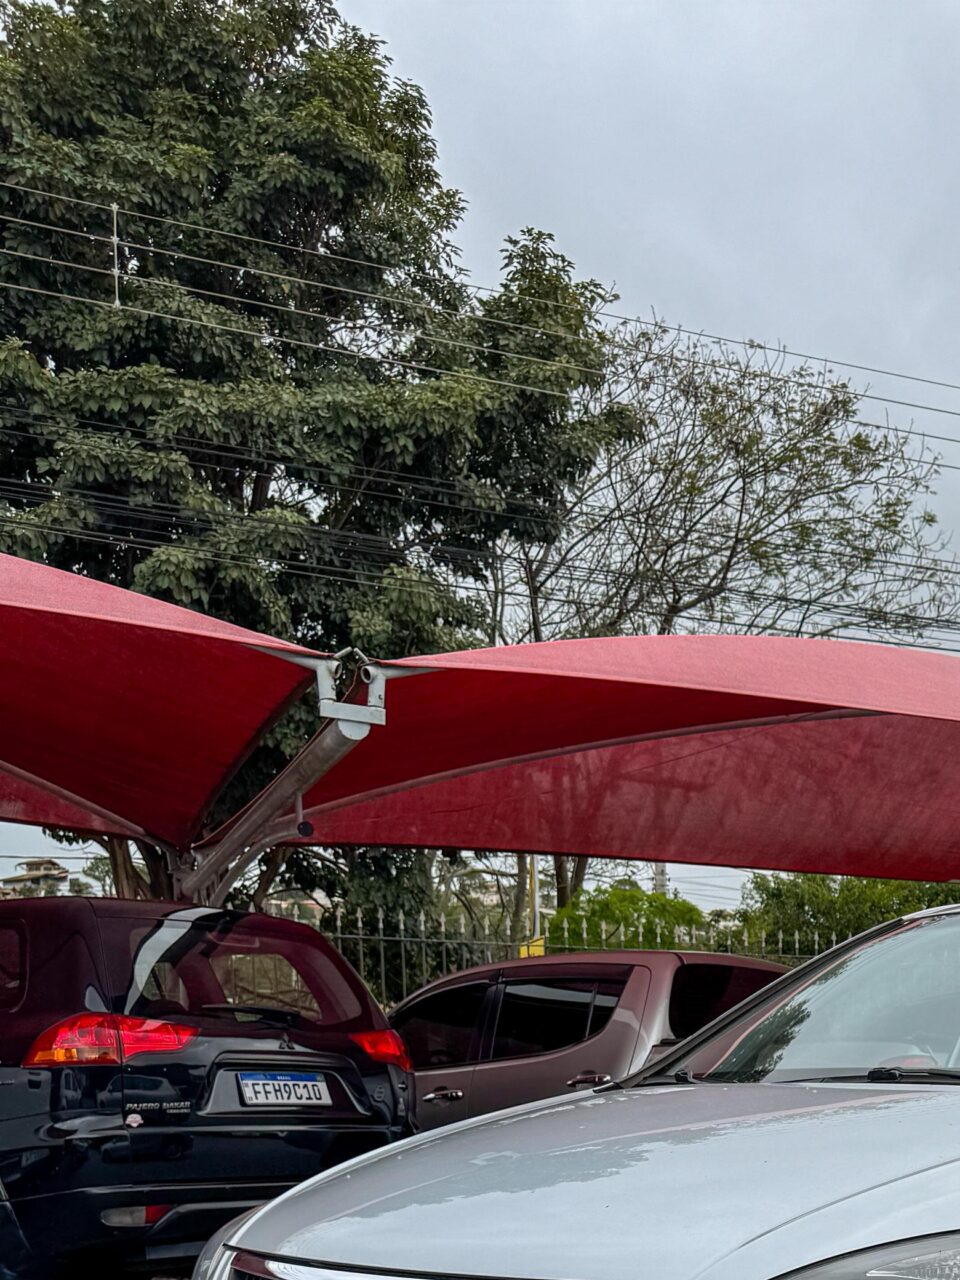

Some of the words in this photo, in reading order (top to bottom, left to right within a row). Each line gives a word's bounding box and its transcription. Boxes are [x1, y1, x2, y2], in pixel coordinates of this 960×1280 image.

[251, 1083, 322, 1101] FFH9C10
[126, 1102, 160, 1111] PAJERO
[162, 1101, 191, 1109] DAKAR
